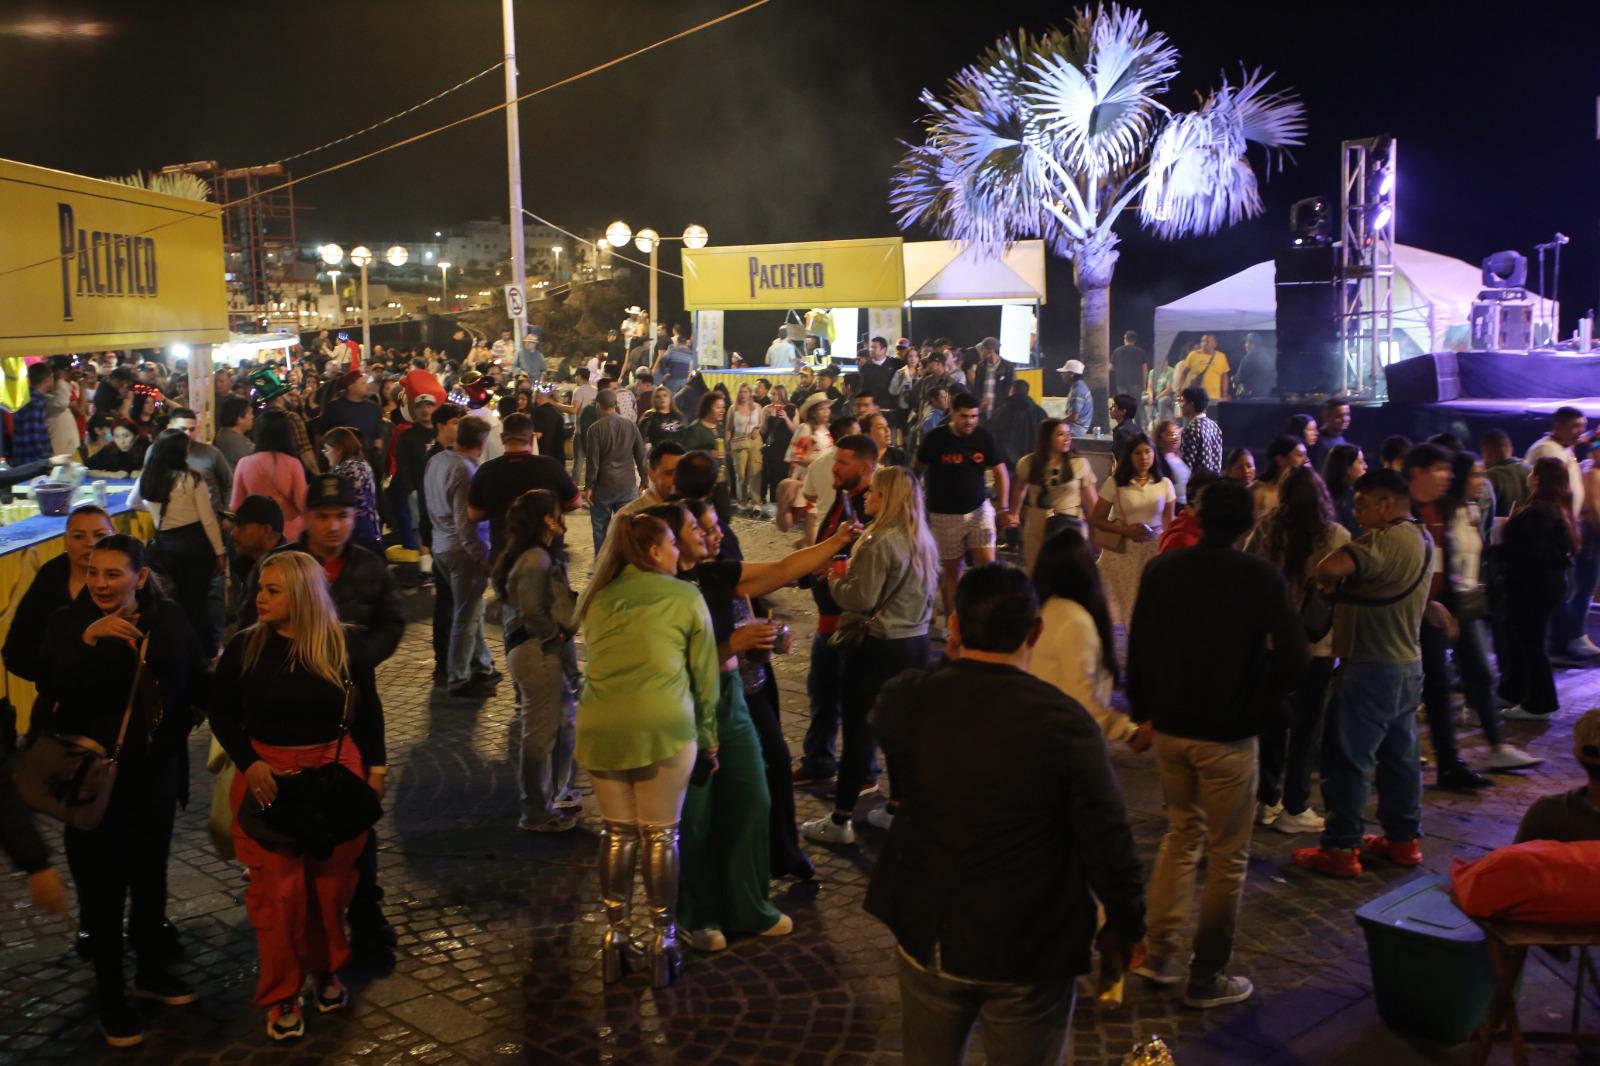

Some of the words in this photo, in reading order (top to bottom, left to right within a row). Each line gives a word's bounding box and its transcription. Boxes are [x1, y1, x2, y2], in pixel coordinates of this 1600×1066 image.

[57, 203, 158, 322] PACIFICO
[748, 256, 825, 299] PACIFICO
[941, 451, 985, 464] HUO
